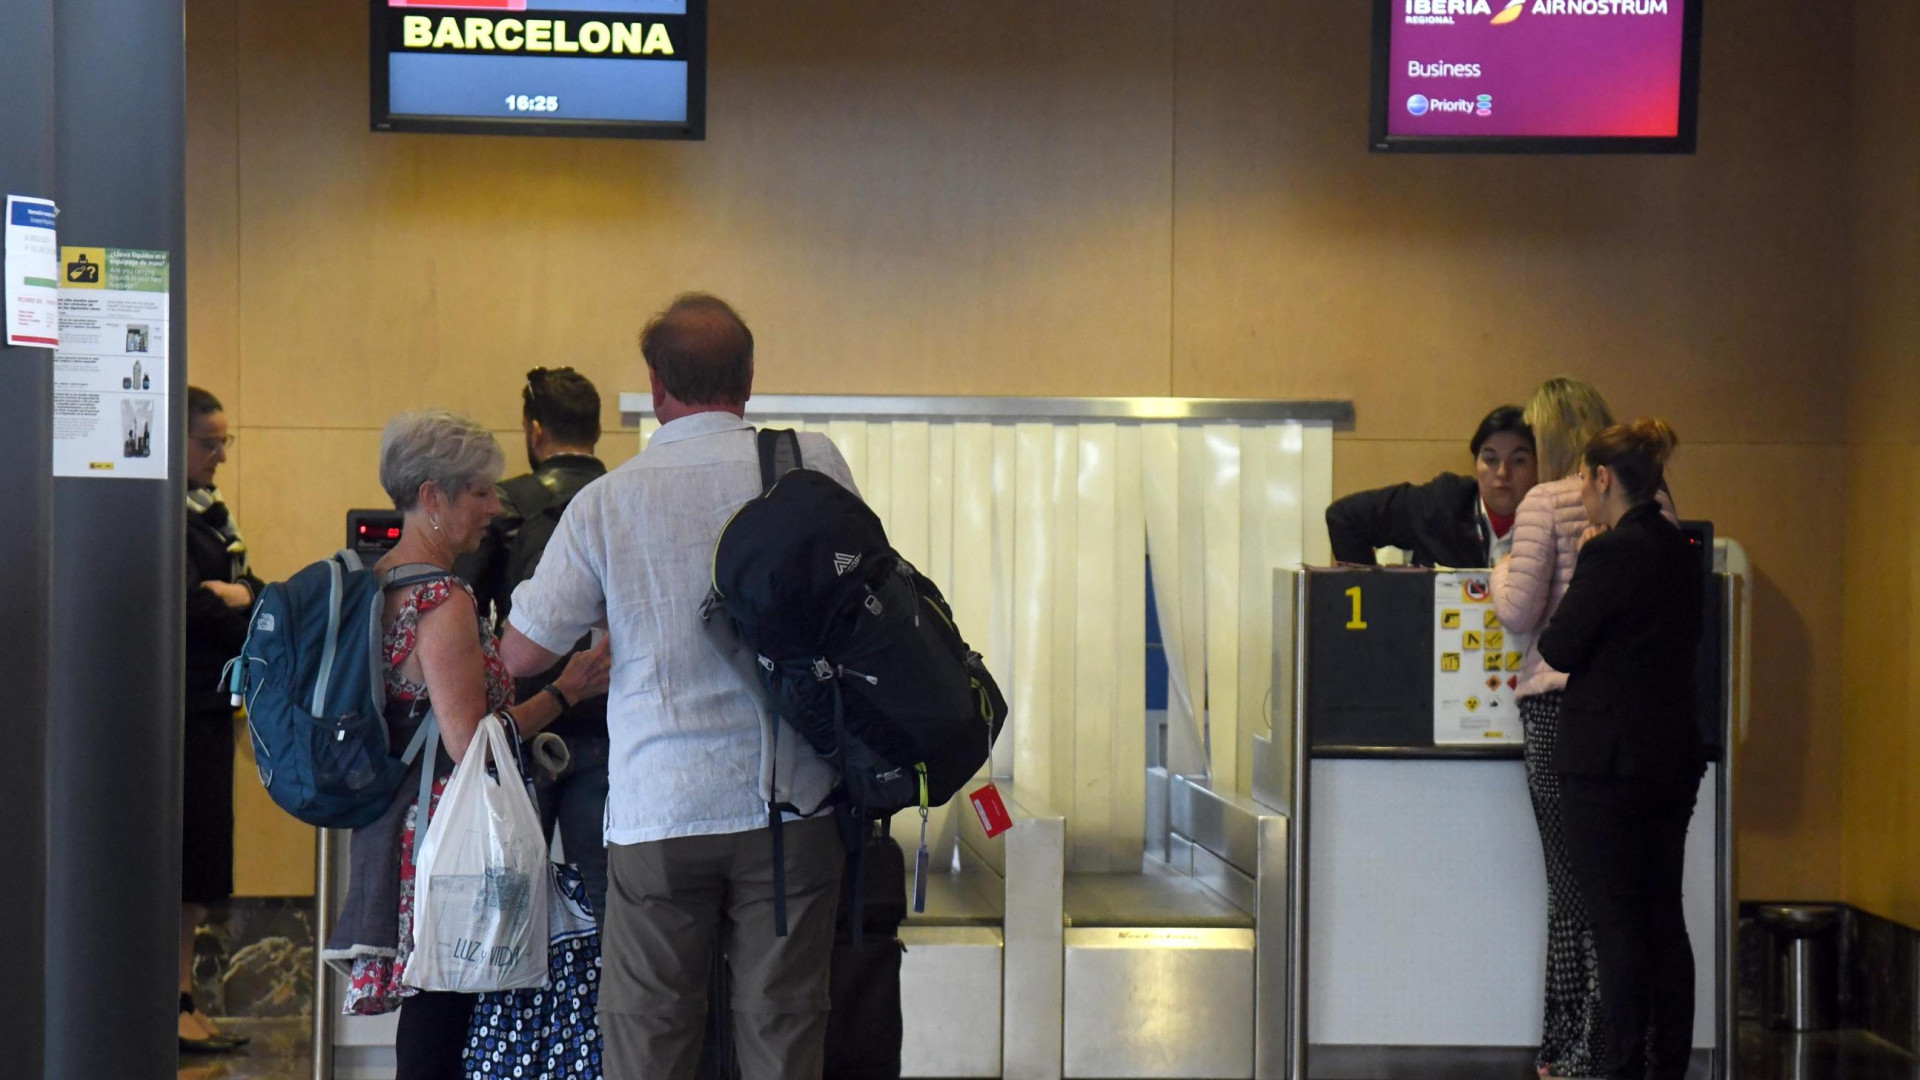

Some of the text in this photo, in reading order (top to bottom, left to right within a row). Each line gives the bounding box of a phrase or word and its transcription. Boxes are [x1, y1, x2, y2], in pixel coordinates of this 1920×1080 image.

[1405, 0, 1491, 14] IBERIA
[1405, 16, 1455, 24] REGIONAL
[403, 15, 674, 54] BARCELONA
[1408, 60, 1482, 78] Business
[505, 94, 558, 111] 16:25
[1430, 98, 1474, 113] Priority
[1345, 586, 1368, 629] 1
[454, 938, 482, 962] LUZ
[489, 945, 520, 966] VIDA
